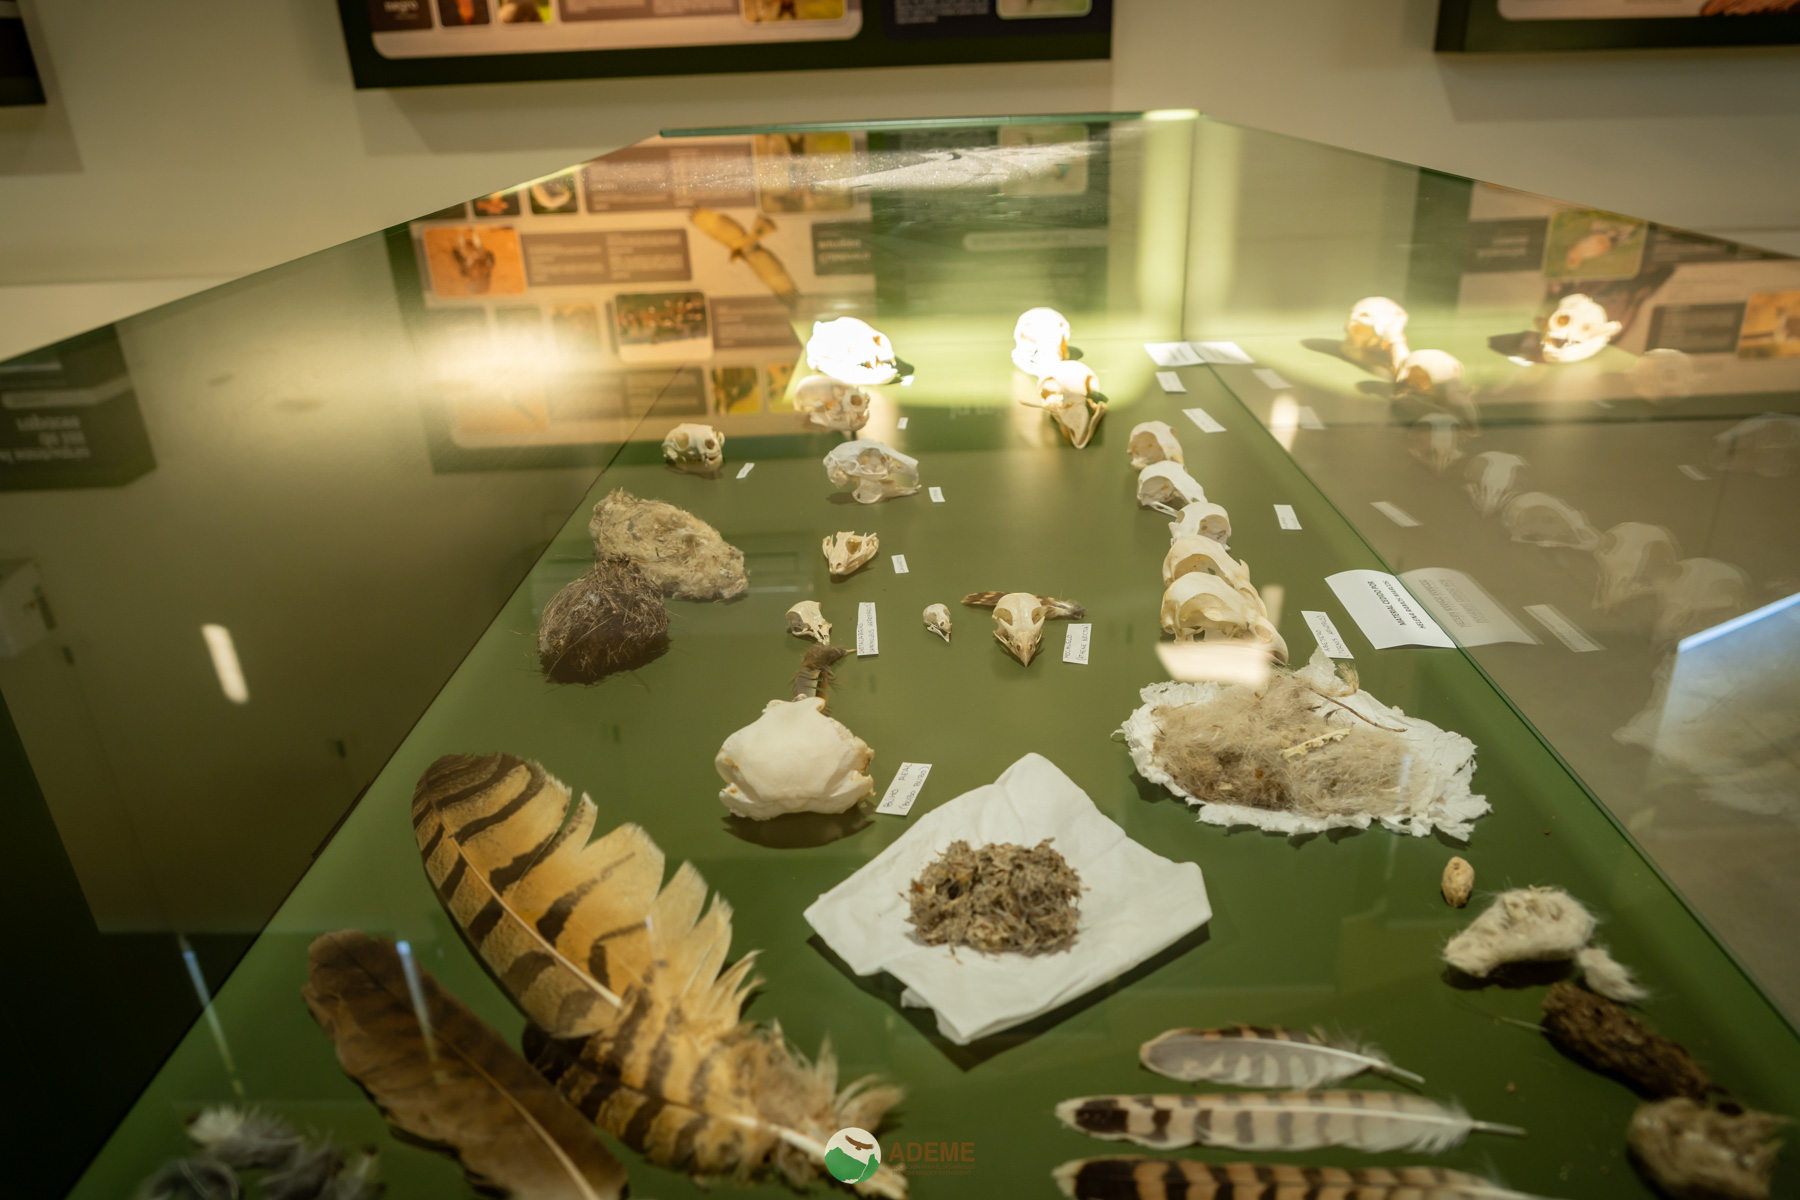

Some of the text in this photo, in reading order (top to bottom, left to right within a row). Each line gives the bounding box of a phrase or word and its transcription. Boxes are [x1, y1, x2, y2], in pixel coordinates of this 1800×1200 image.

[1367, 581, 1406, 625] MATERIAL CEDIDO POR
[1397, 597, 1412, 612] RAMOS
[1408, 612, 1426, 629] HELENA
[898, 763, 913, 781] REAL
[898, 766, 930, 809] (BUBO BUBO)
